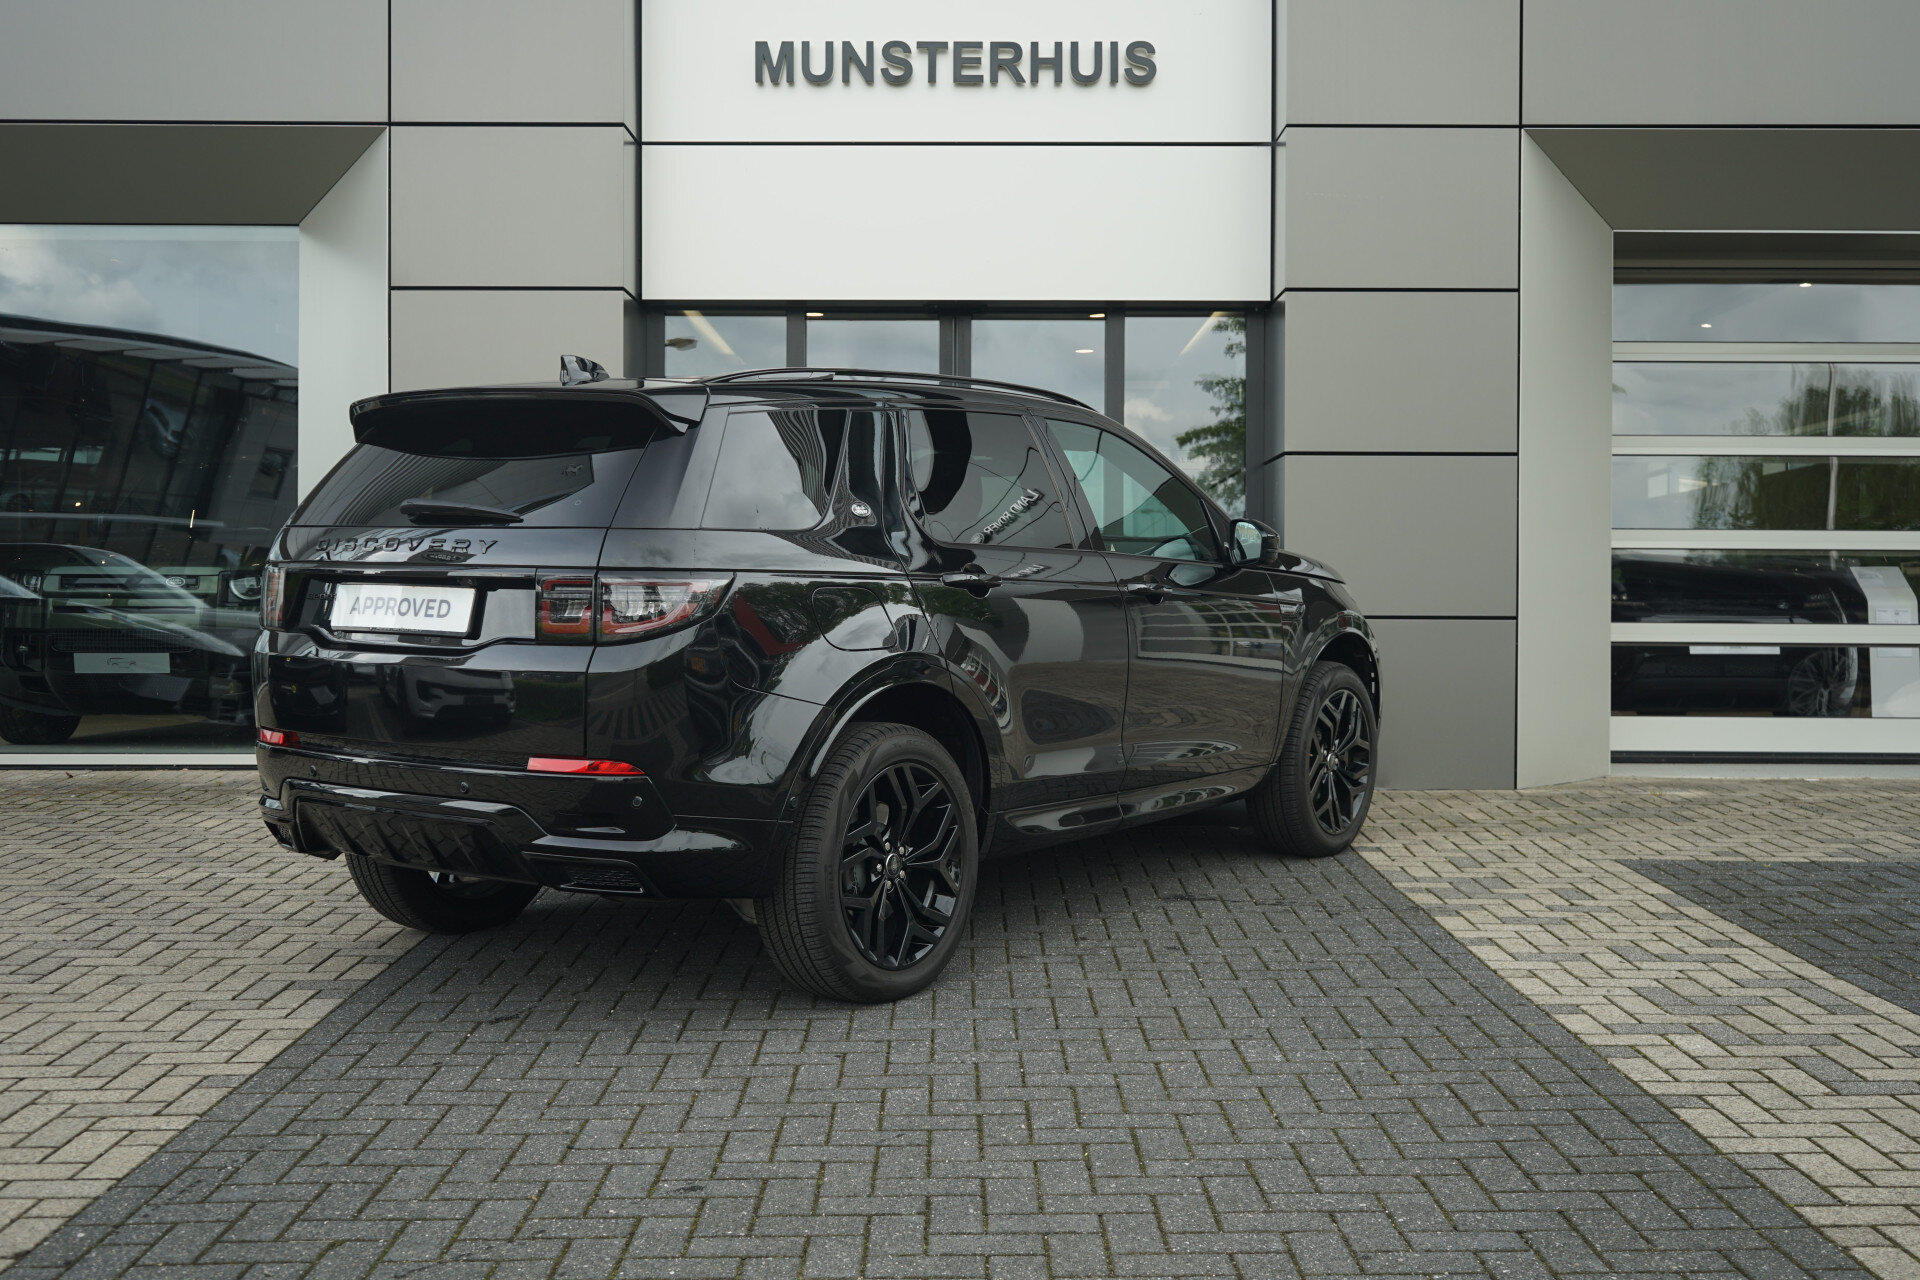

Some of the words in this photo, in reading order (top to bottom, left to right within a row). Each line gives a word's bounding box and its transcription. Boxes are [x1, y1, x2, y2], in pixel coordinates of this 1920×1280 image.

[754, 40, 1158, 86] MUNSTERHUIS
[315, 536, 499, 555] DISCOVERY
[349, 596, 452, 619] APPROVED
